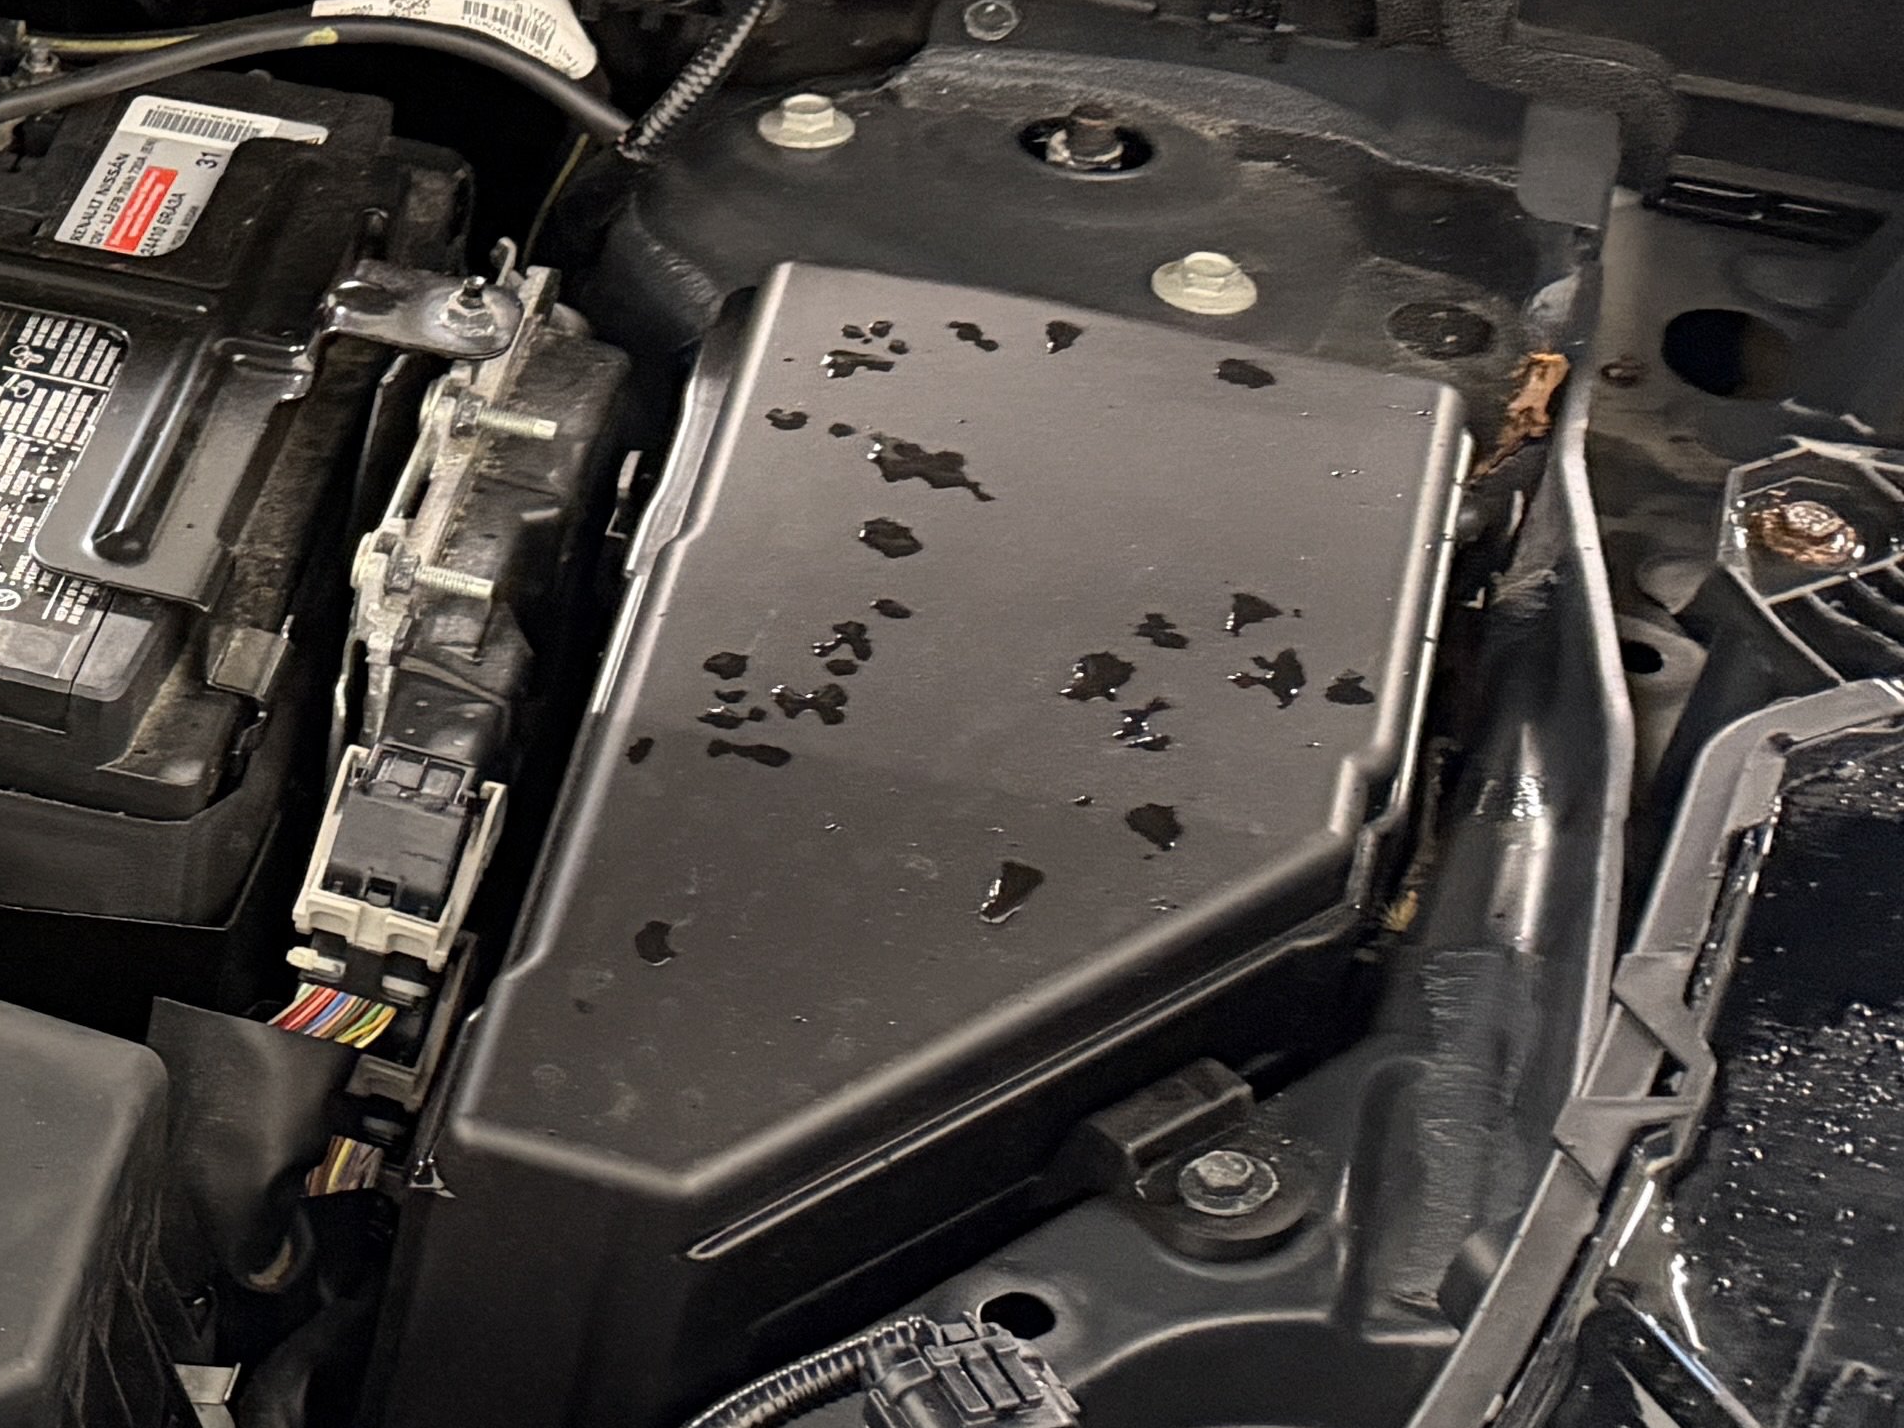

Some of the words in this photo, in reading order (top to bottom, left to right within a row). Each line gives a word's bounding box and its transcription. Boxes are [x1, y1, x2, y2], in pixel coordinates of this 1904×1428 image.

[195, 151, 222, 168] 31
[70, 199, 102, 242] RENAULT
[95, 153, 130, 195] NISSAN
